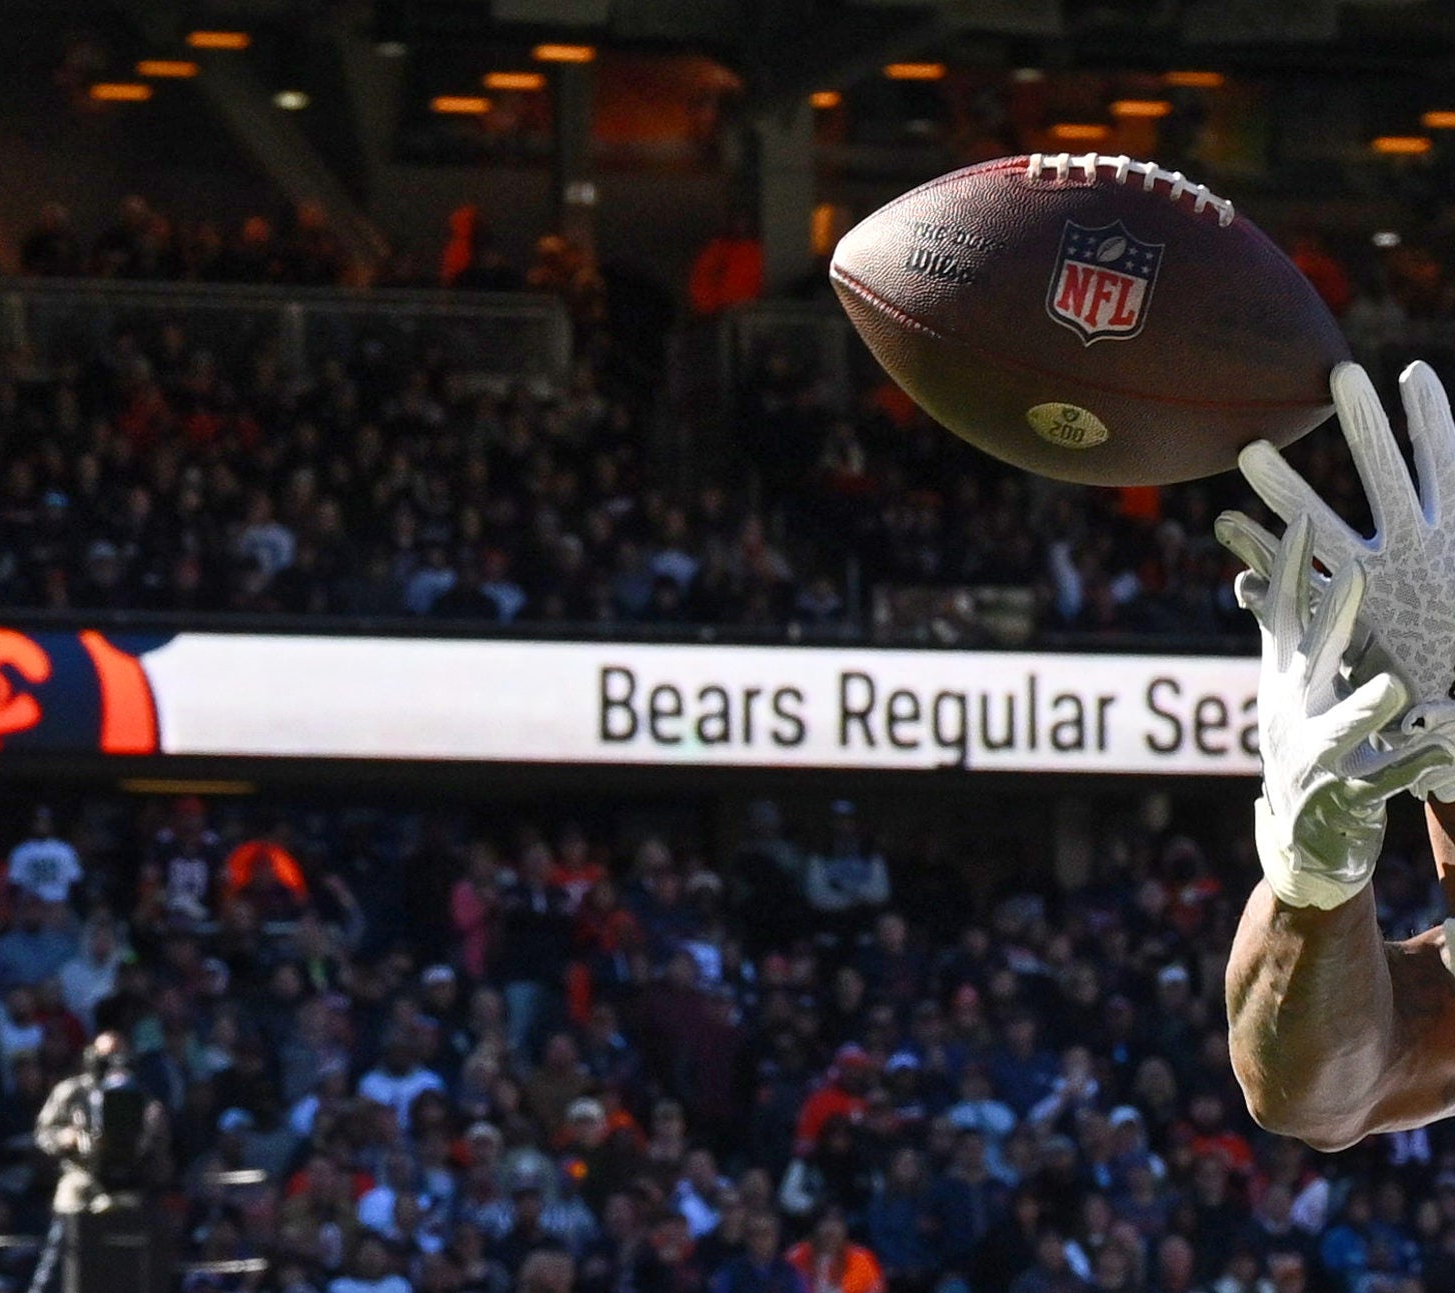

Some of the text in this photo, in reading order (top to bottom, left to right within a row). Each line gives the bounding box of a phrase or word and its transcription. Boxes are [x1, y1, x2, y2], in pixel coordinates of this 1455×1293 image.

[1057, 263, 1136, 329] NFL
[598, 665, 808, 748] Bears
[838, 671, 1116, 767] Regular
[1144, 677, 1262, 757] Sea
